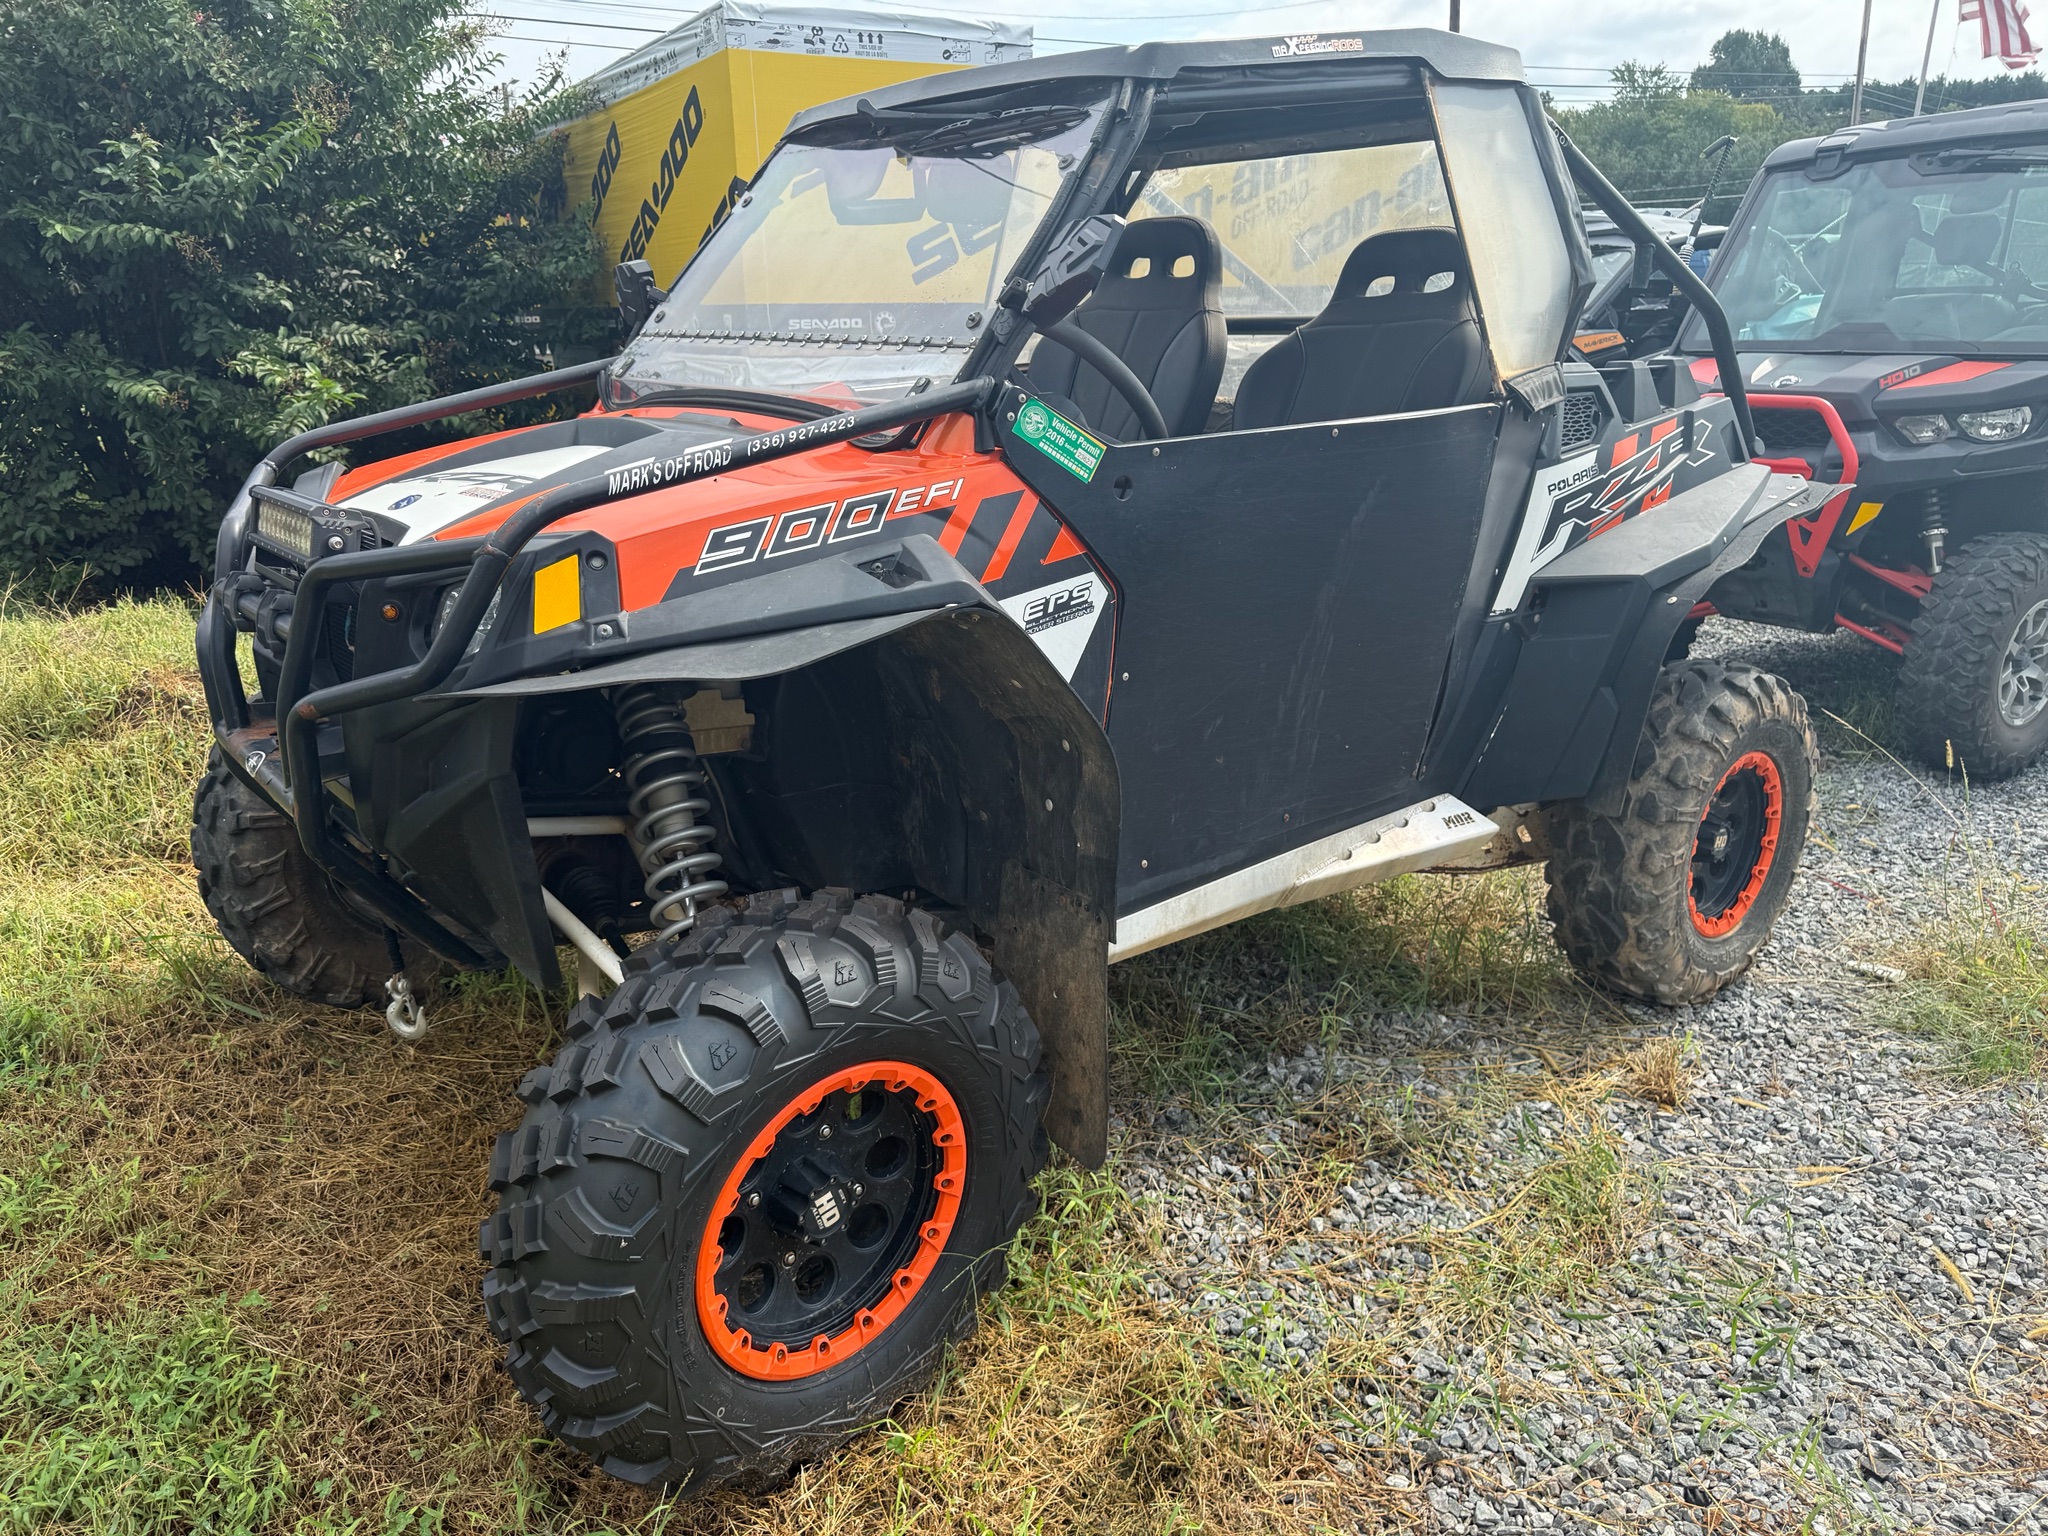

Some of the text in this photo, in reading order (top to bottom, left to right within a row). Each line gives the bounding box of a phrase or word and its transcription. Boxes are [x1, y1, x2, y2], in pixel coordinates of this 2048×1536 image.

[1880, 365, 1920, 389] HD10
[1045, 428, 1066, 447] 2016
[1052, 417, 1077, 441] Vehicle
[1077, 436, 1100, 458] Permit
[608, 416, 855, 496] MARK'S OFF ROAD (336) 927-4223
[1547, 463, 1599, 495] POLARIS
[693, 478, 965, 576] 900 EFI
[1023, 581, 1093, 622] EPS
[1026, 601, 1094, 628] ELECTRONIC
[1056, 606, 1095, 625] STEERING
[814, 1190, 841, 1228] HD
